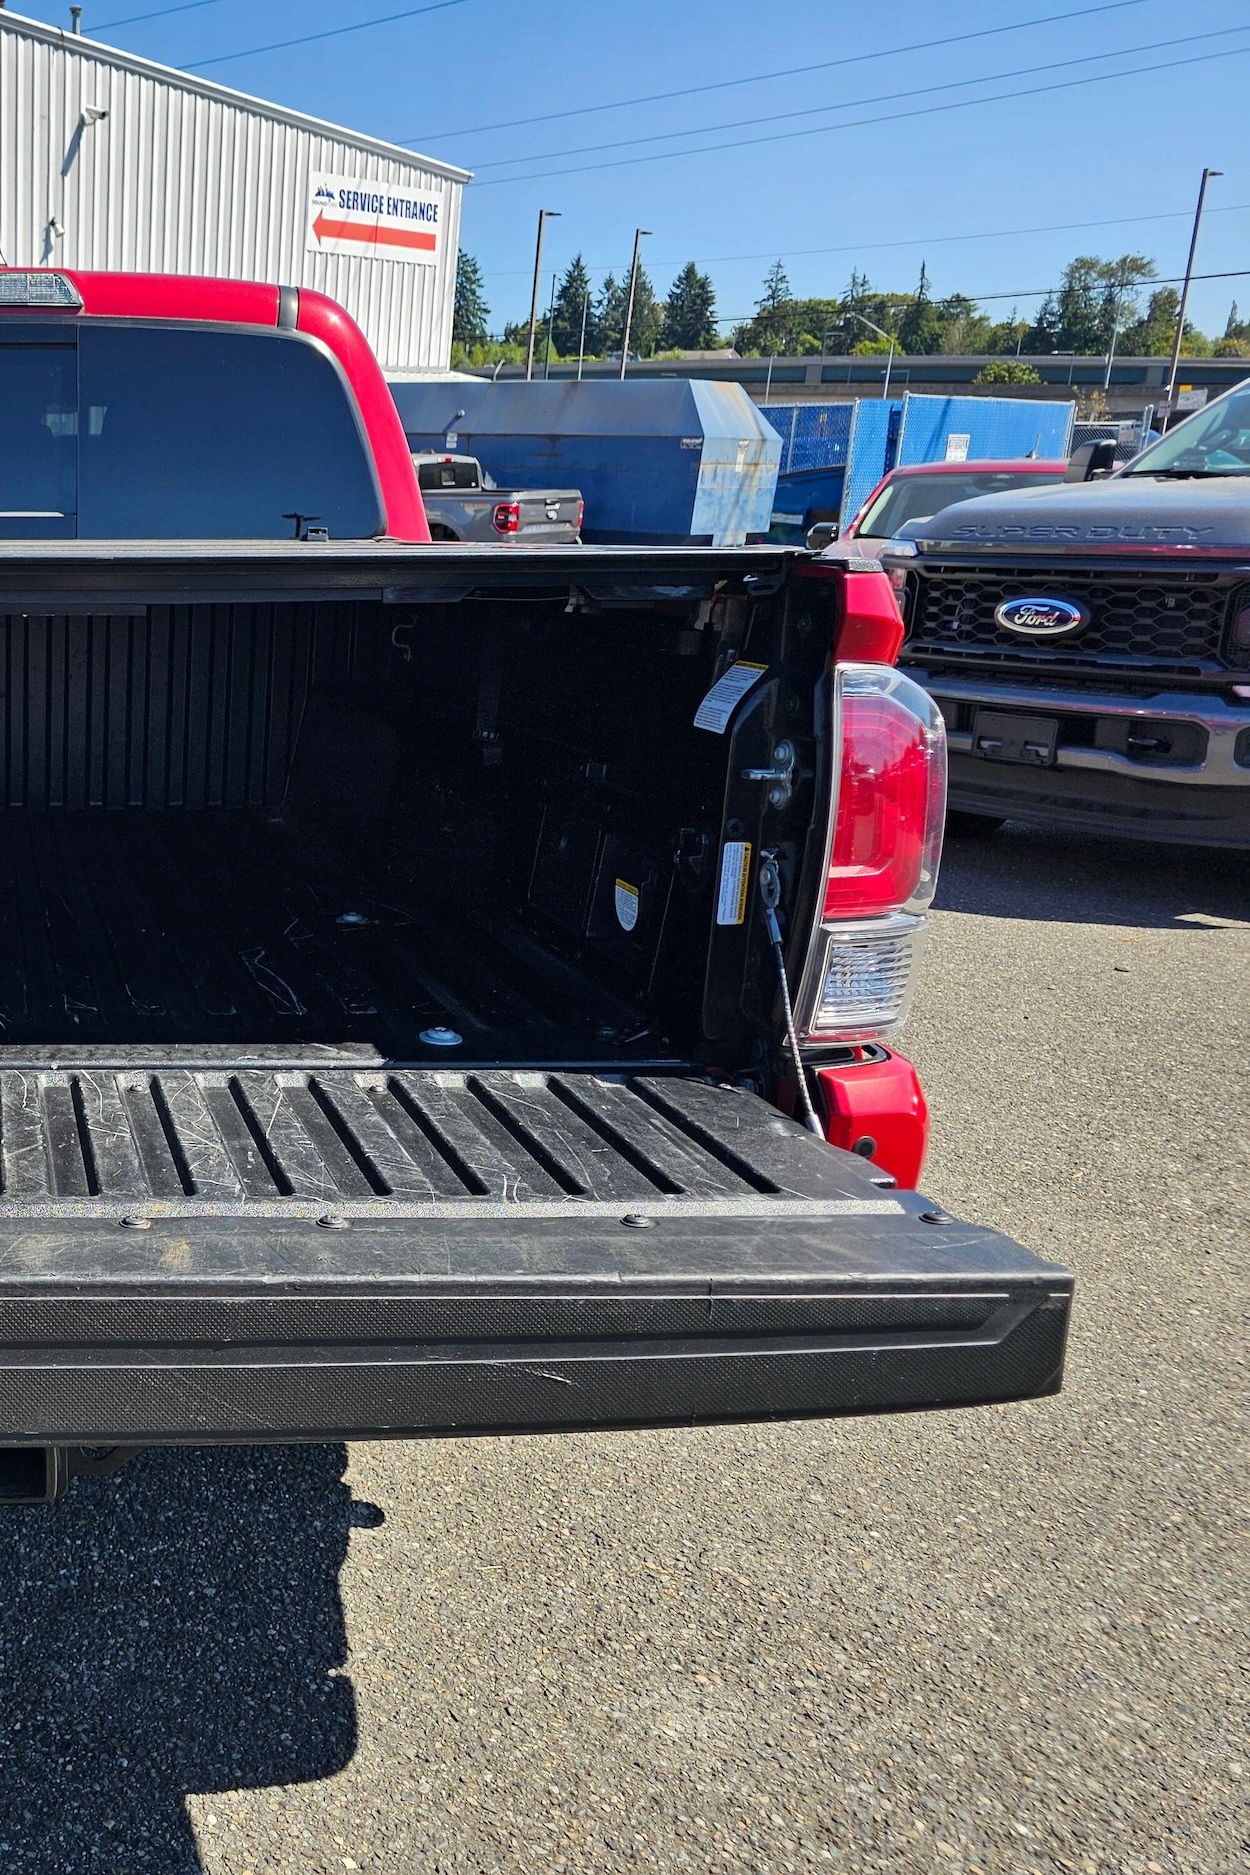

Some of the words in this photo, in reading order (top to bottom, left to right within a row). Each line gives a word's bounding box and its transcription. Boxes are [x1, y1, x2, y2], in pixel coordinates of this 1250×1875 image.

[339, 189, 384, 214] SERVICE
[387, 197, 439, 222] ENTRANCE
[952, 525, 1078, 539] SUPER
[1086, 526, 1215, 541] DUTY
[1014, 604, 1058, 628] Ford
